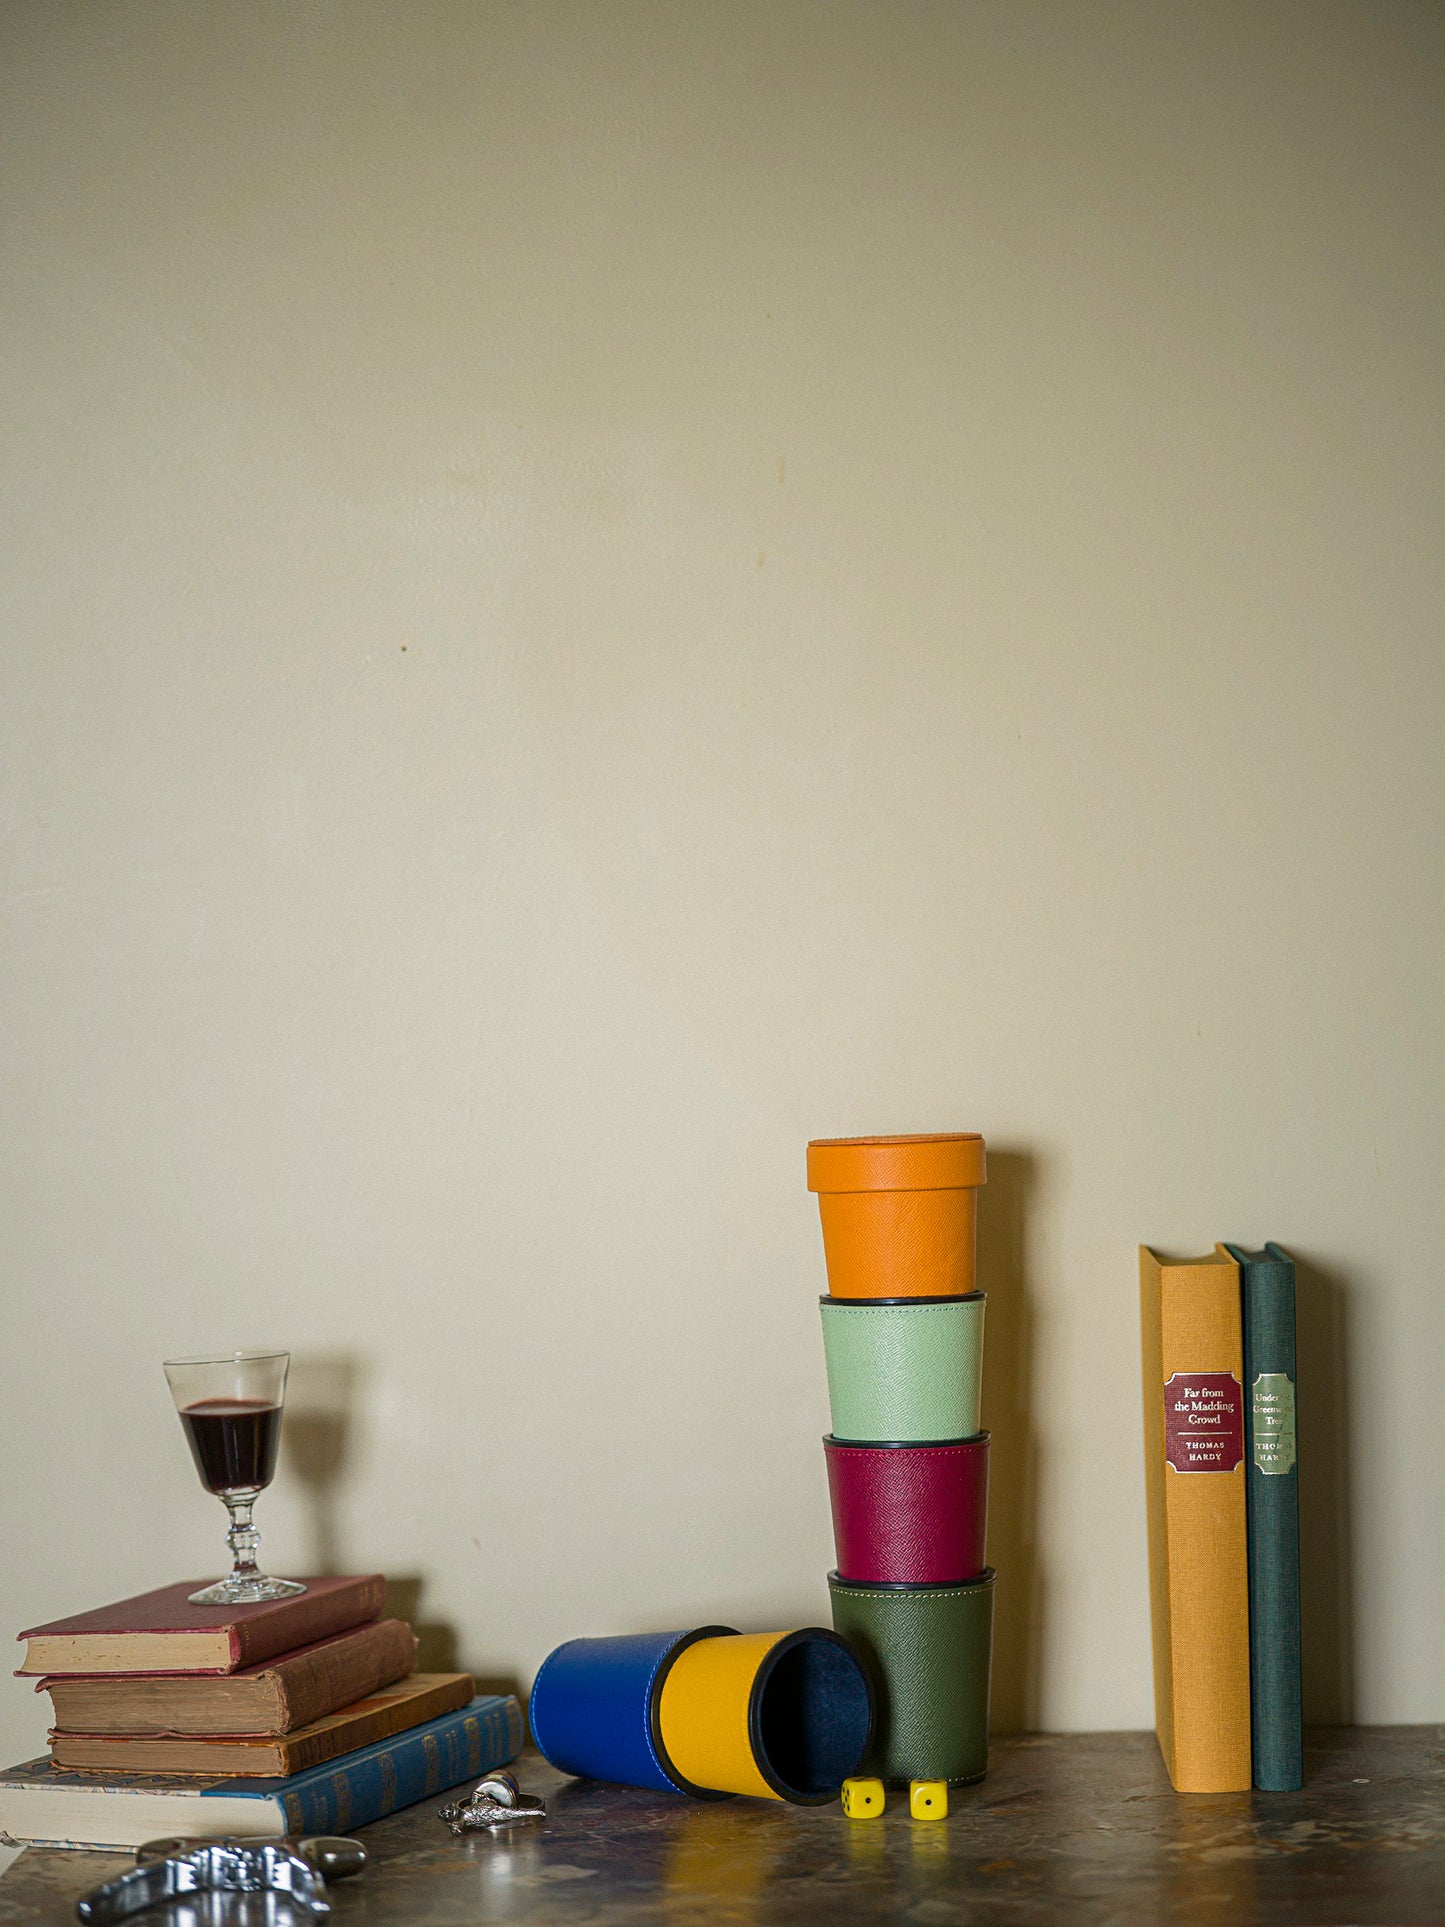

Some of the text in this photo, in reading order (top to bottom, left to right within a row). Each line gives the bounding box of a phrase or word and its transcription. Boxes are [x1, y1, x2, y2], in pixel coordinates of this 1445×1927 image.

[1184, 1388, 1223, 1398] Far from
[1255, 1393, 1280, 1402] Under
[1175, 1401, 1234, 1413] the Madding
[1188, 1414, 1221, 1425] Crowd
[1186, 1442, 1225, 1450] THOMAS
[1189, 1453, 1222, 1461] HARDY
